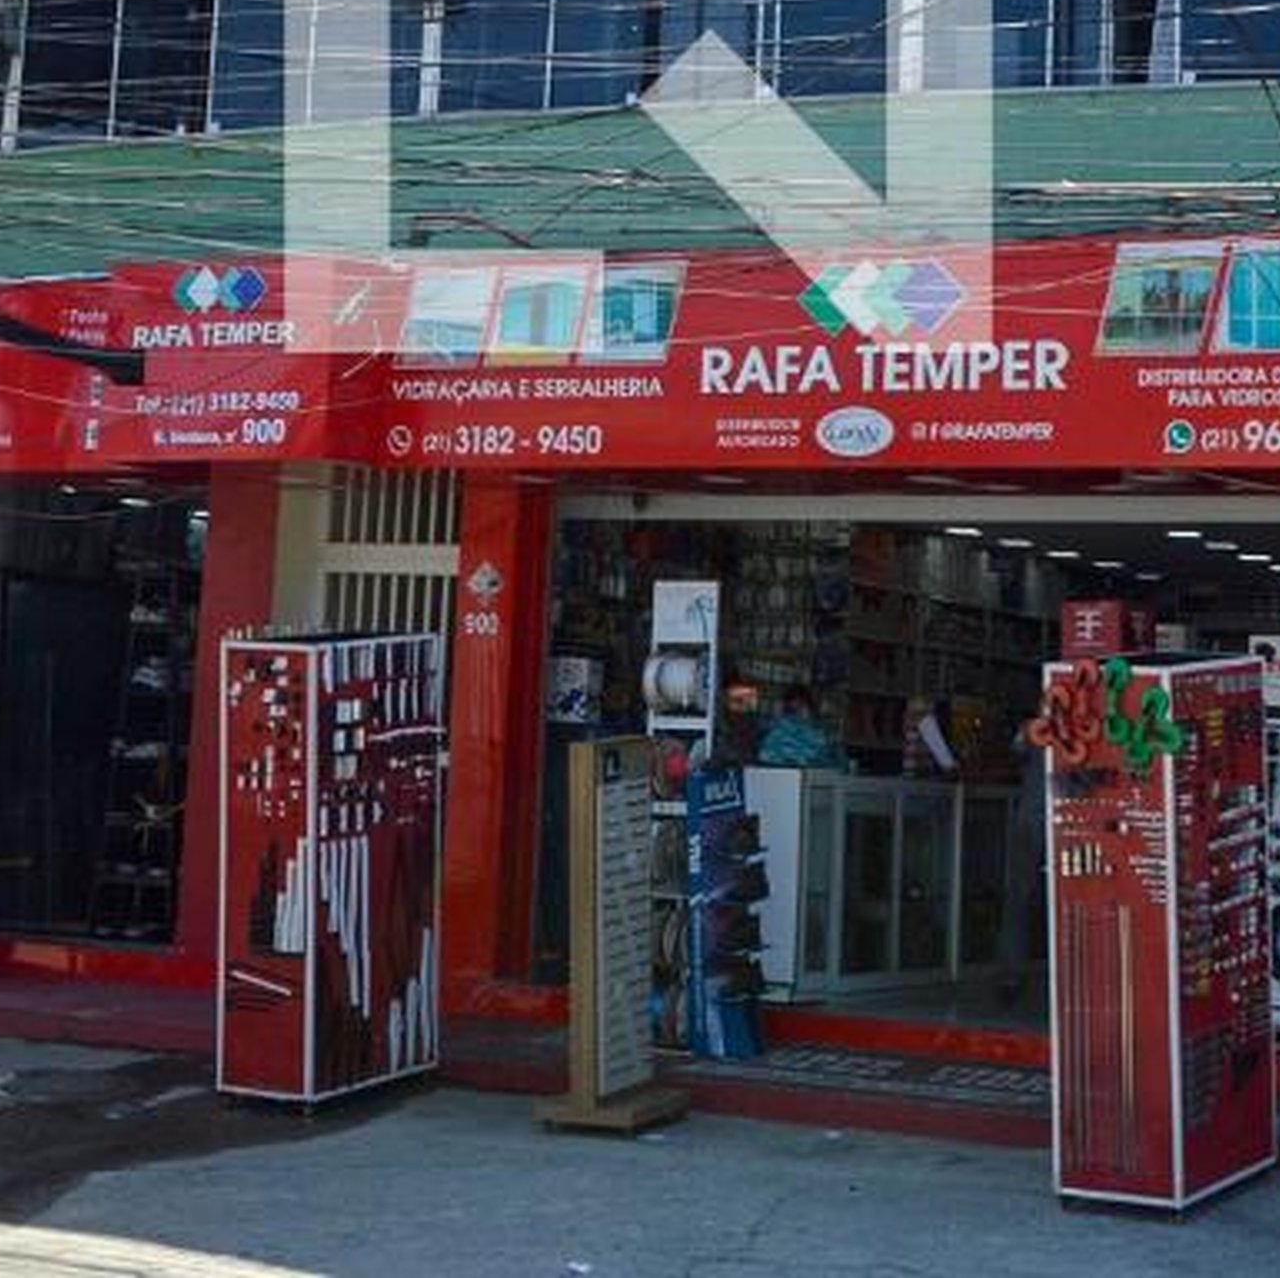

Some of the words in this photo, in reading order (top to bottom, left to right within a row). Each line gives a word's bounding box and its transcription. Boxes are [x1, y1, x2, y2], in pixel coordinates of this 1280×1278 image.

[133, 324, 194, 349] RAFA
[200, 321, 295, 346] TEMPER
[699, 344, 841, 394] RAFA
[855, 339, 1070, 392] TEMPER
[1138, 367, 1268, 388] DISTRIBUIDORA
[392, 379, 514, 407] VIDRAÇARIA
[519, 379, 529, 399] E
[533, 375, 664, 399] SERRALHERIA
[1168, 389, 1216, 406] PARA
[243, 419, 286, 443] 900
[454, 425, 515, 454] 3182
[536, 424, 603, 454] 9450
[1200, 428, 1239, 452] (21)
